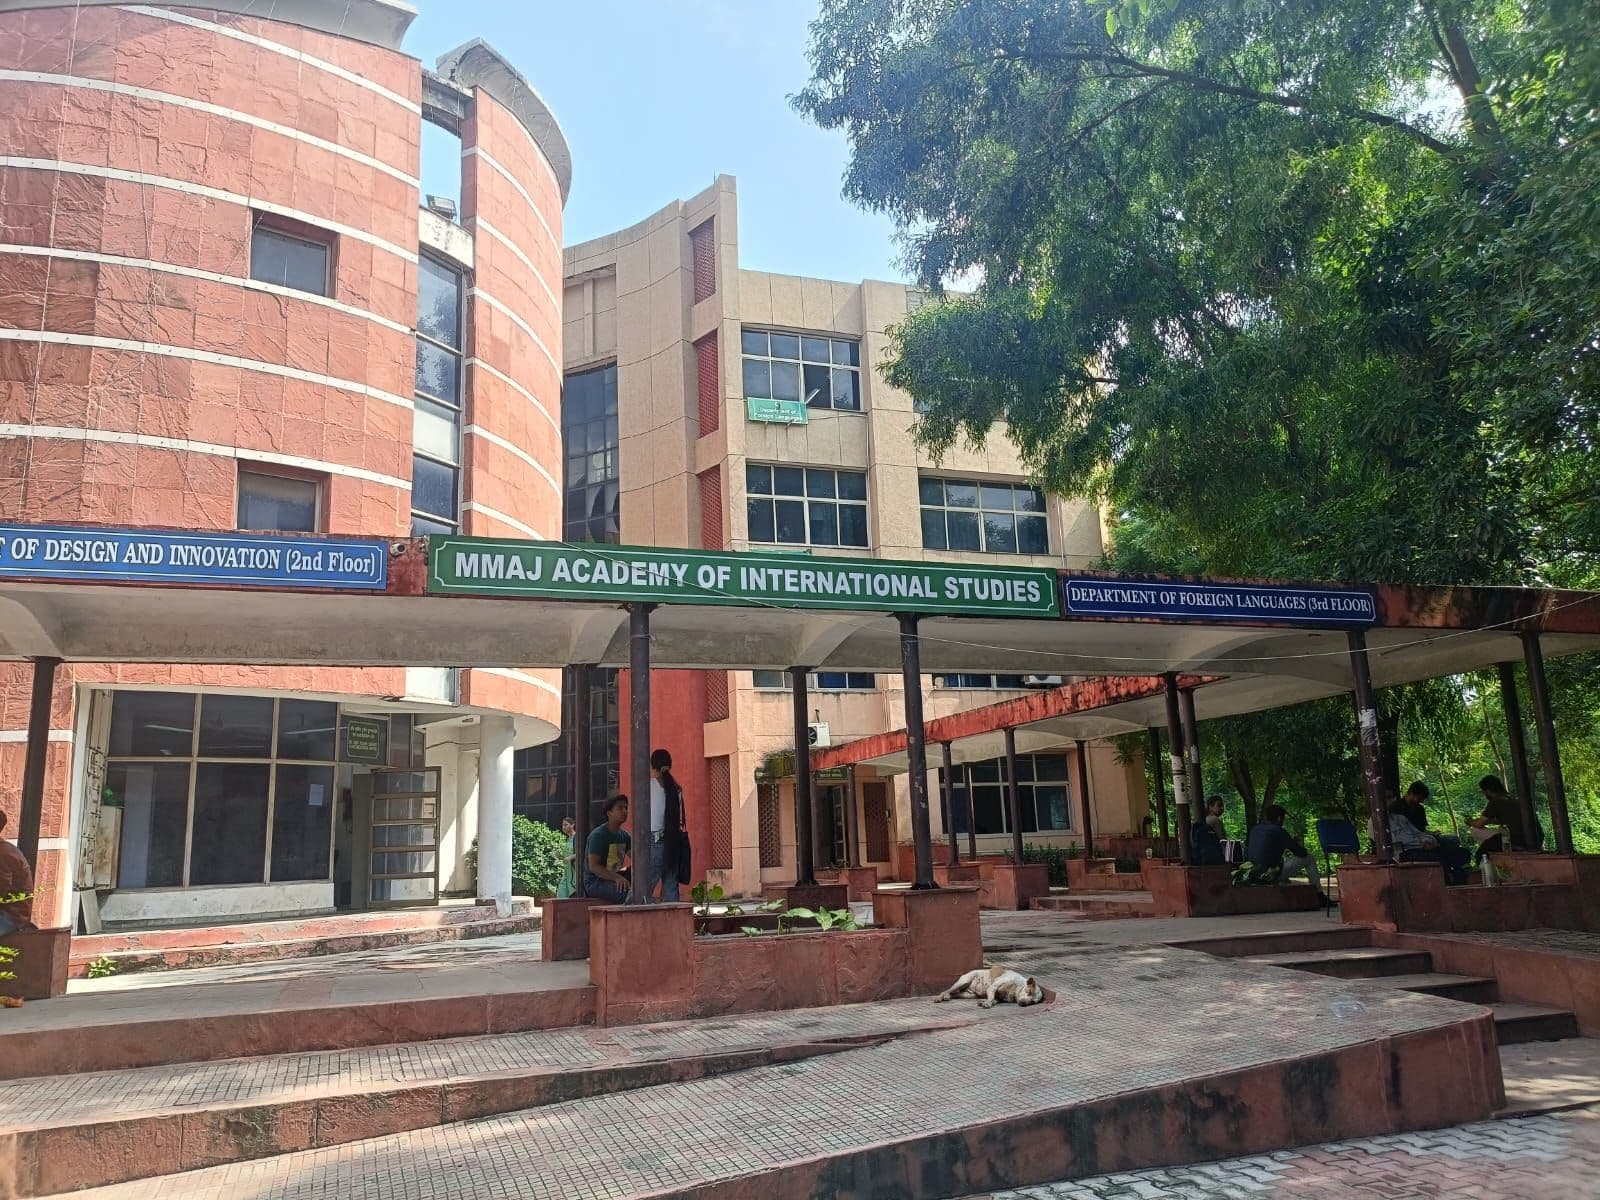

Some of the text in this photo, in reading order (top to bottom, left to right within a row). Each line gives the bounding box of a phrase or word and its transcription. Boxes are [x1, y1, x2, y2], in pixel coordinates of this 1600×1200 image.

[11, 537, 39, 560] OF
[44, 539, 119, 562] DESIGN
[123, 542, 163, 564] AND
[169, 544, 281, 569] INNOVATION
[286, 548, 322, 573] (2nd
[328, 552, 375, 577] Floor)
[455, 552, 1041, 602] MMAJ ACADEMY OF INTERNATIONAL STUDIES
[1071, 587, 1372, 615] DEPARTMENT OF FOREIGN LANGUAGES (3rd FLOOR)
